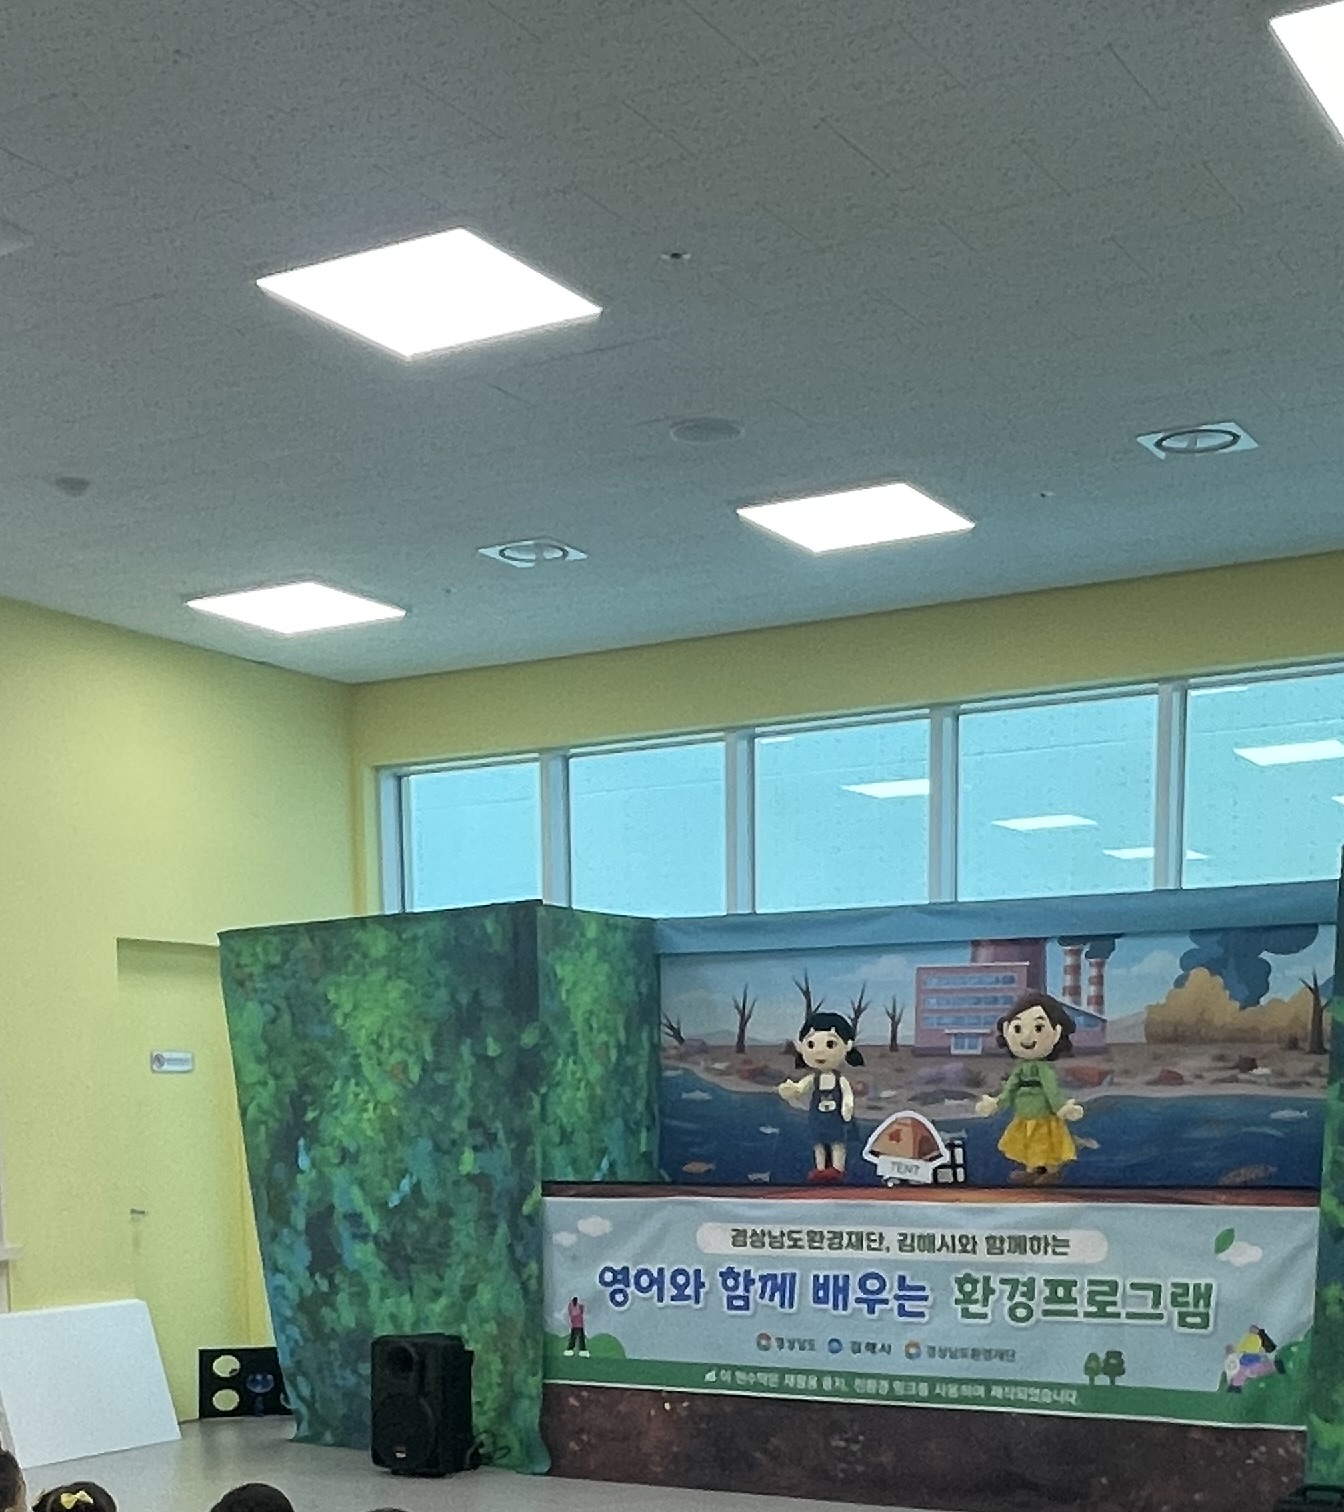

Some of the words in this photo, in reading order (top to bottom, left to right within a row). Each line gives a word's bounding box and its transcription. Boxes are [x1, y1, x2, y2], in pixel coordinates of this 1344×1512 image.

[890, 1161, 920, 1176] TENT
[731, 1228, 890, 1253] 경상남도환경재단,
[897, 1232, 977, 1256] 김해시와
[985, 1234, 1070, 1256] 함께하는
[598, 1265, 705, 1307] 영어와
[718, 1266, 796, 1311] 함께
[812, 1271, 929, 1318] 배우는
[954, 1272, 1213, 1330] 환경프로그램
